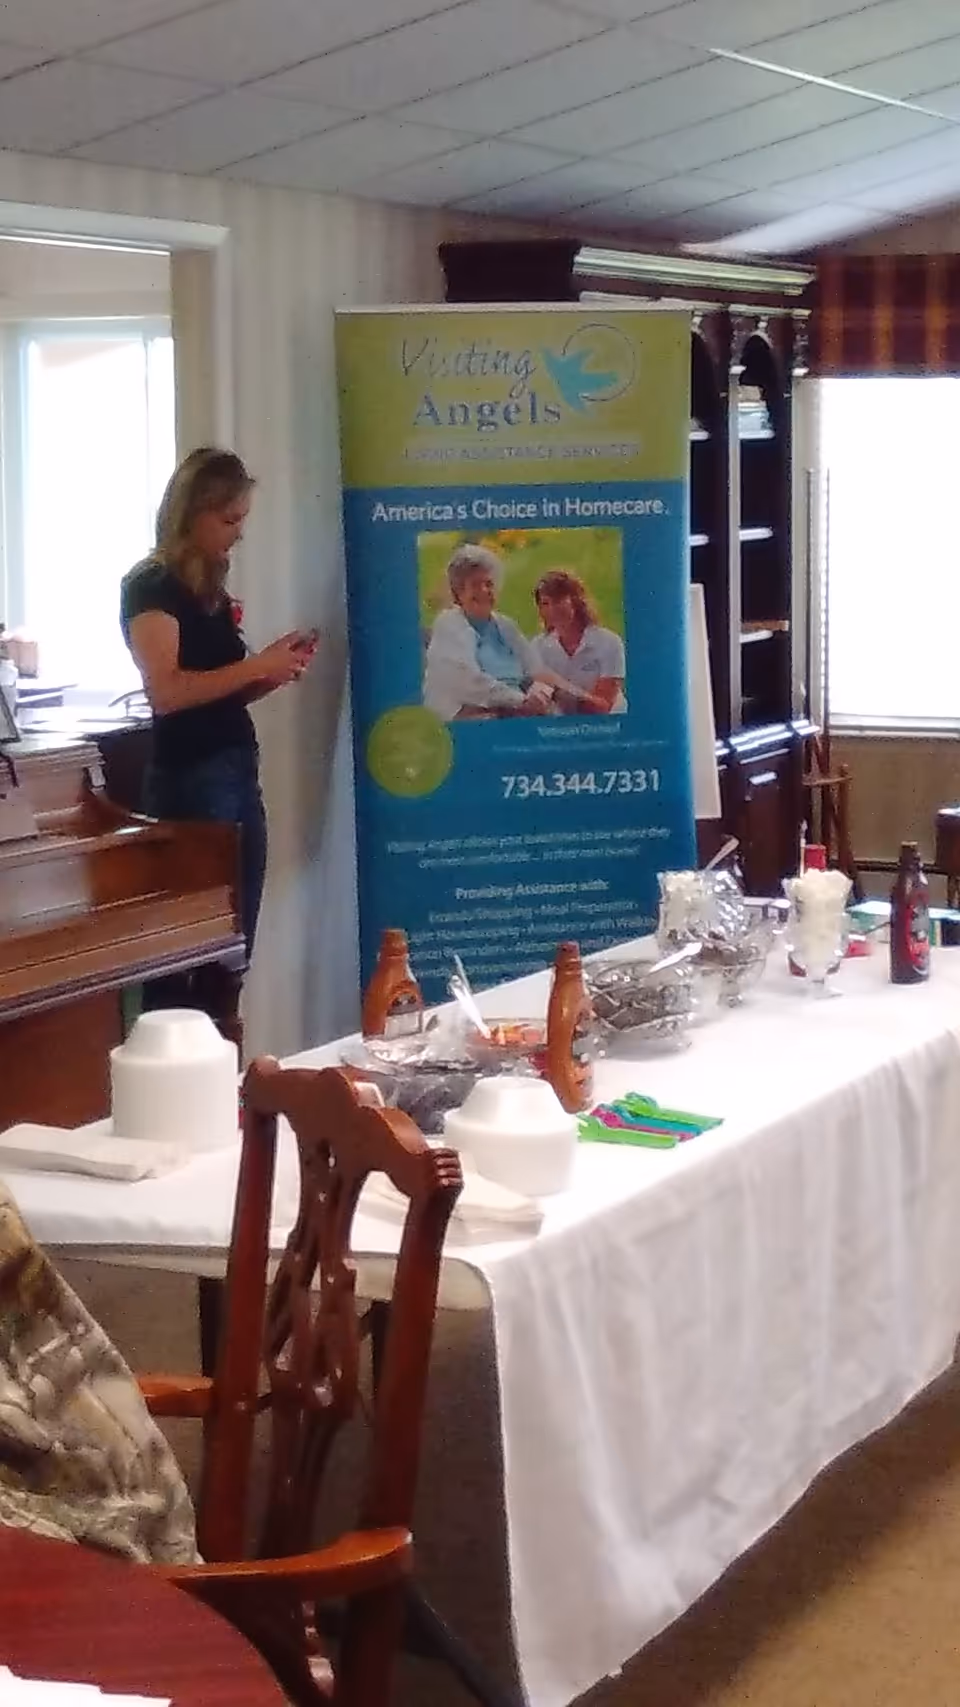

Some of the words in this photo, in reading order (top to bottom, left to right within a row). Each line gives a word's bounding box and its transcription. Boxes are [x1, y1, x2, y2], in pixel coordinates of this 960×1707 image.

[402, 337, 537, 399] Visiting
[412, 391, 562, 433] Angels
[371, 500, 468, 522] America's
[471, 498, 537, 520] Choice
[542, 497, 561, 518] in
[500, 768, 661, 799] 734.344.7331
[455, 884, 514, 901] Providing
[515, 881, 577, 899] Assistance
